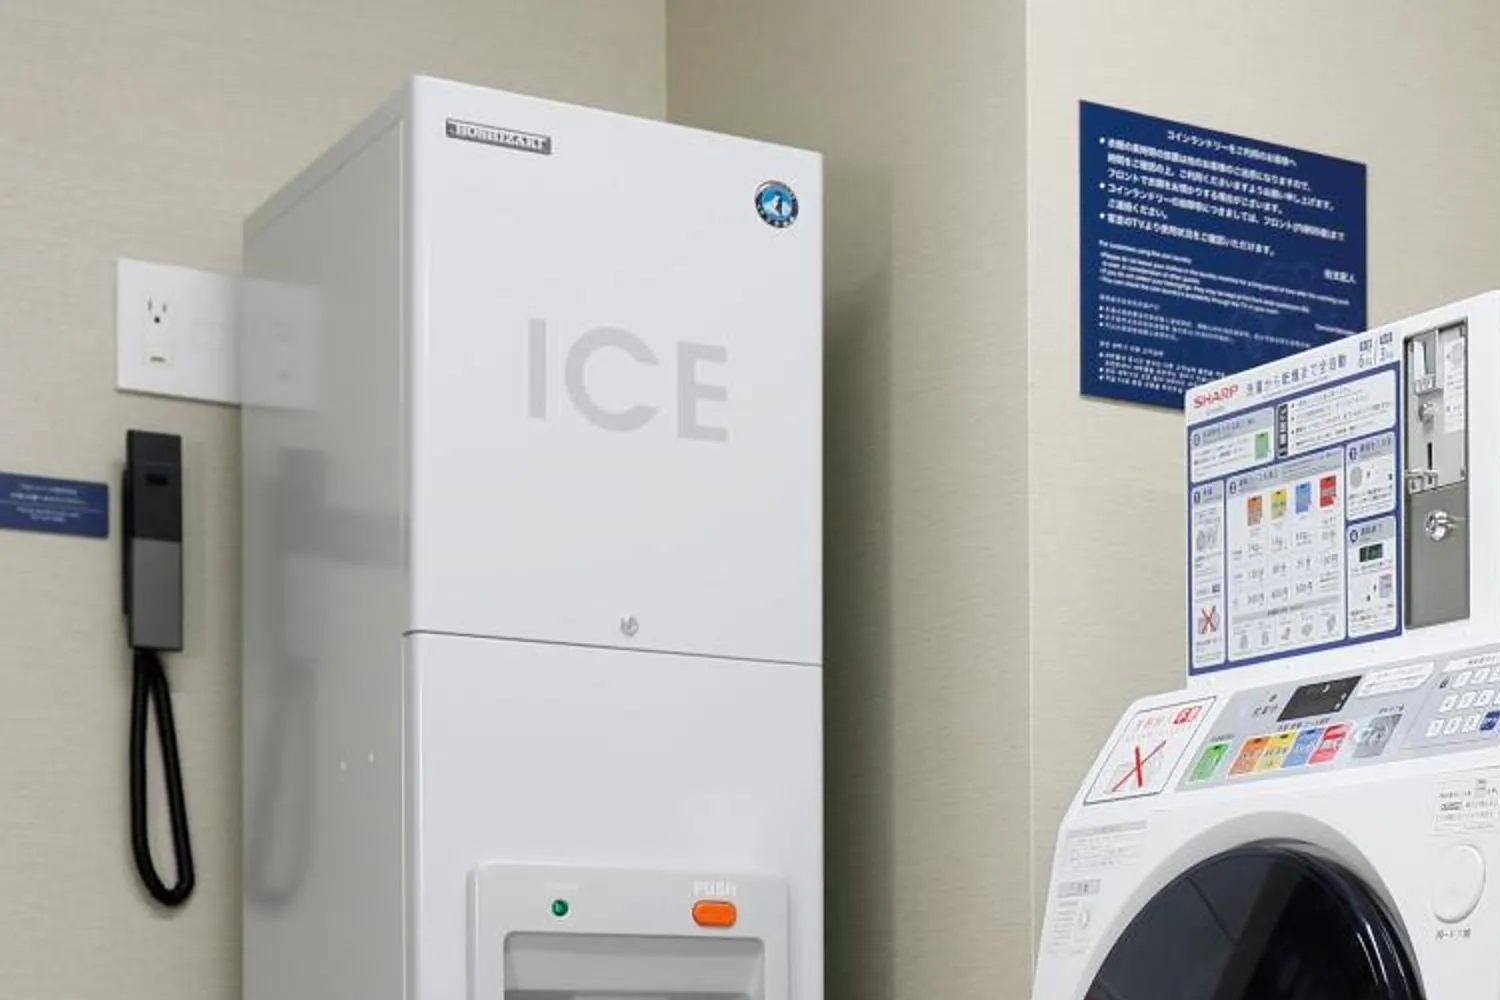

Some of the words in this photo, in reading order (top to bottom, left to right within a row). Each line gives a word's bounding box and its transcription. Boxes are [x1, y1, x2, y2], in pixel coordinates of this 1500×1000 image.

[527, 317, 730, 442] ICE
[1193, 384, 1239, 409] SHARP
[693, 880, 737, 897] PUSH
